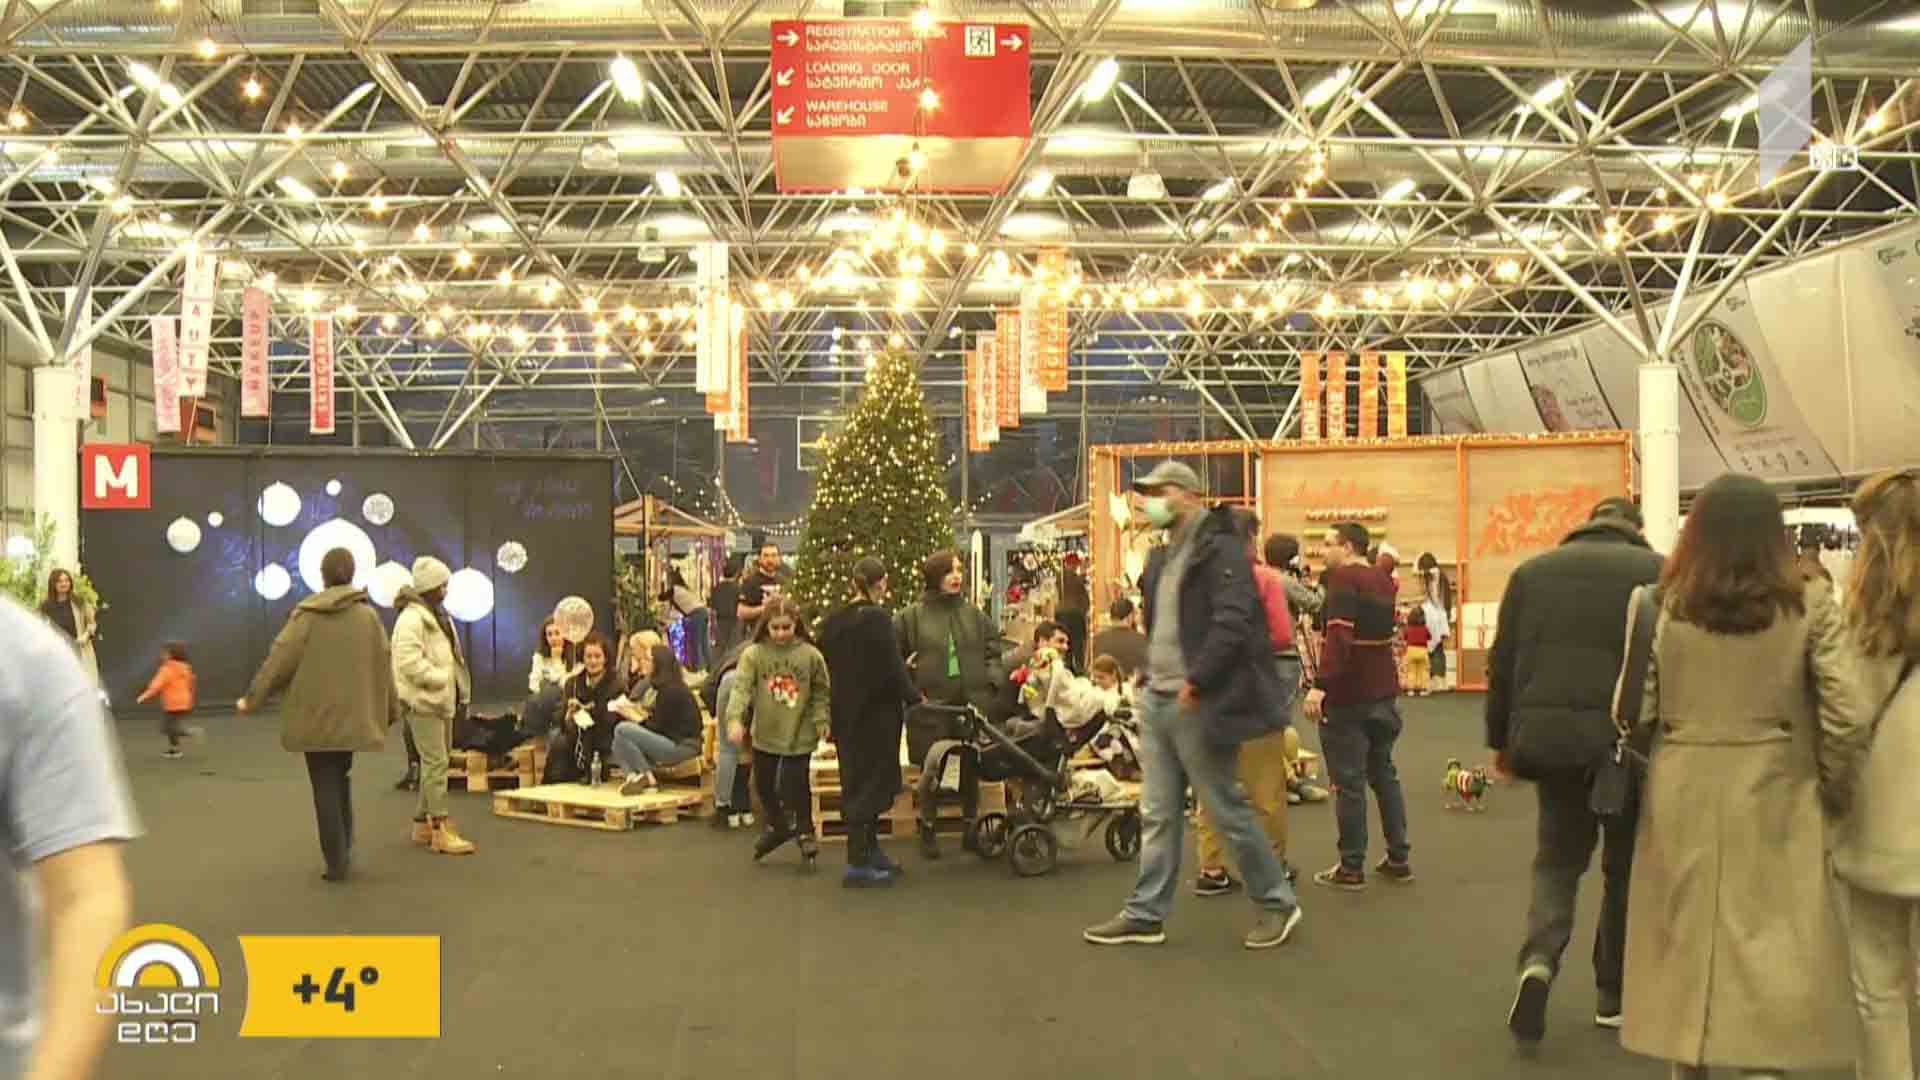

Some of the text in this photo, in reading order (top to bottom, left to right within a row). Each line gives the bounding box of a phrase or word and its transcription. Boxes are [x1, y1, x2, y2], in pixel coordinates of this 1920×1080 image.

[805, 24, 901, 37] REGISTRATION
[805, 61, 911, 74] LOADING DOOR
[805, 99, 888, 112] WAREHOUSE
[95, 454, 138, 498] M
